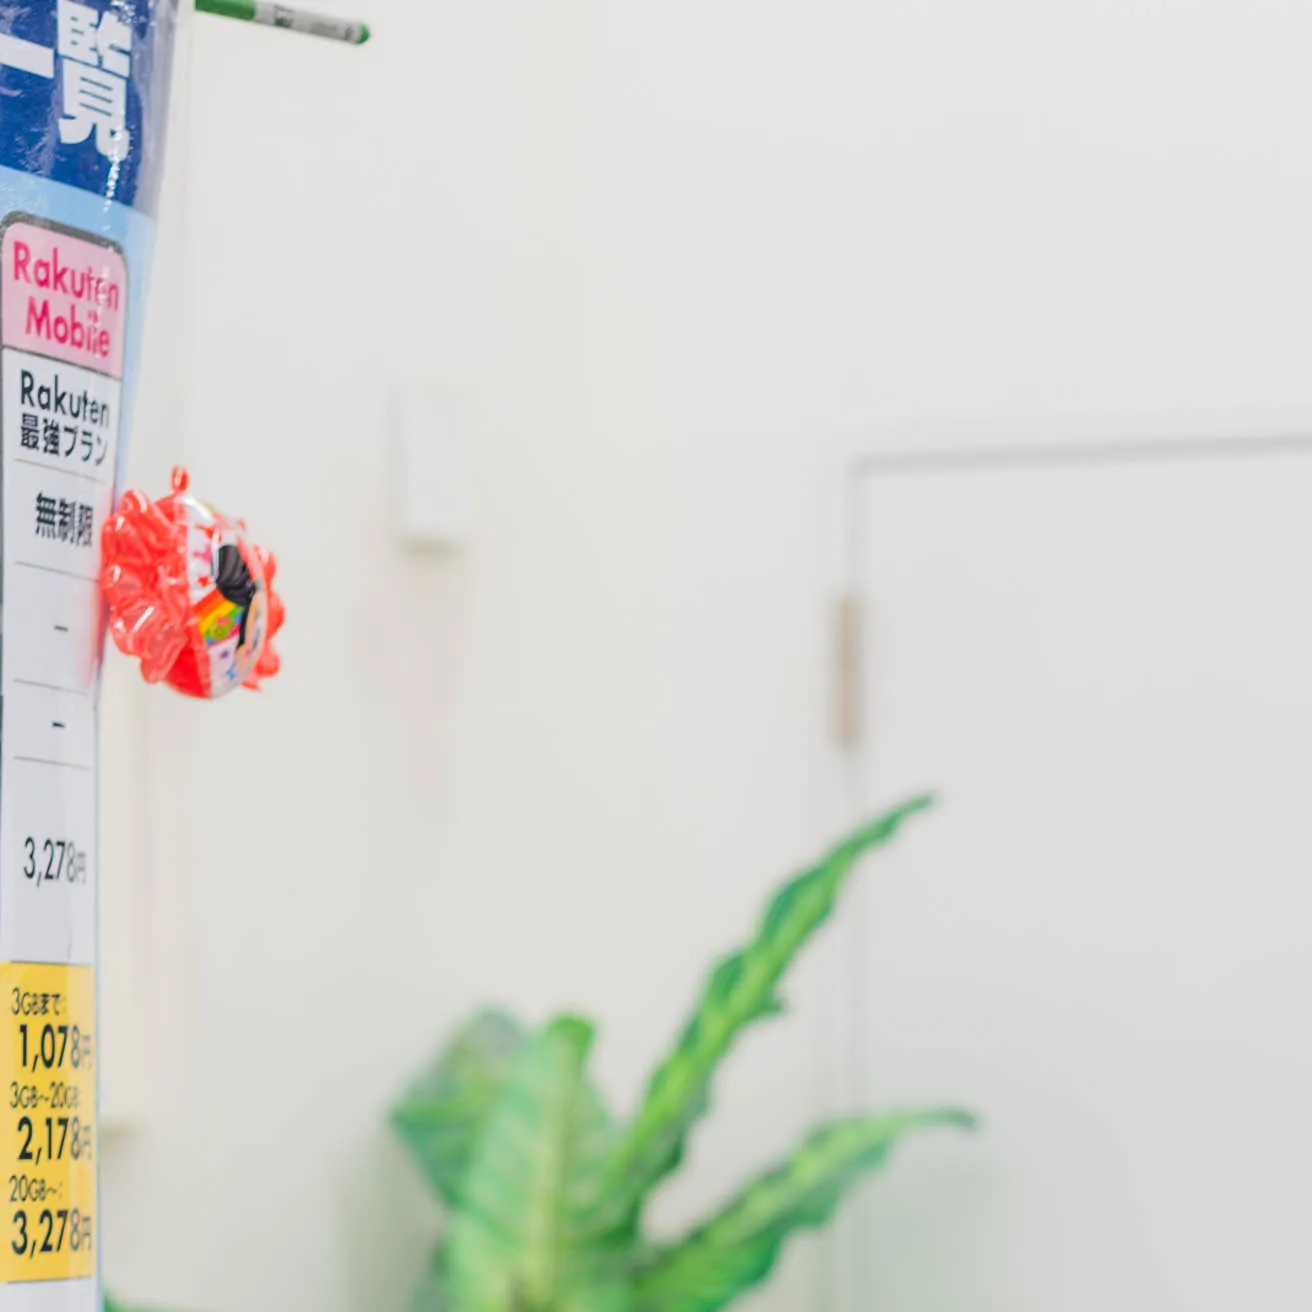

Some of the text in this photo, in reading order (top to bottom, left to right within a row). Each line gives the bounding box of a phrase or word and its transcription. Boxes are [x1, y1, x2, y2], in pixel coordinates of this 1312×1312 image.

[13, 240, 119, 312] Rakuten
[25, 294, 111, 358] Mobile
[21, 369, 110, 428] Rakuten
[20, 412, 108, 466] 最強プラン
